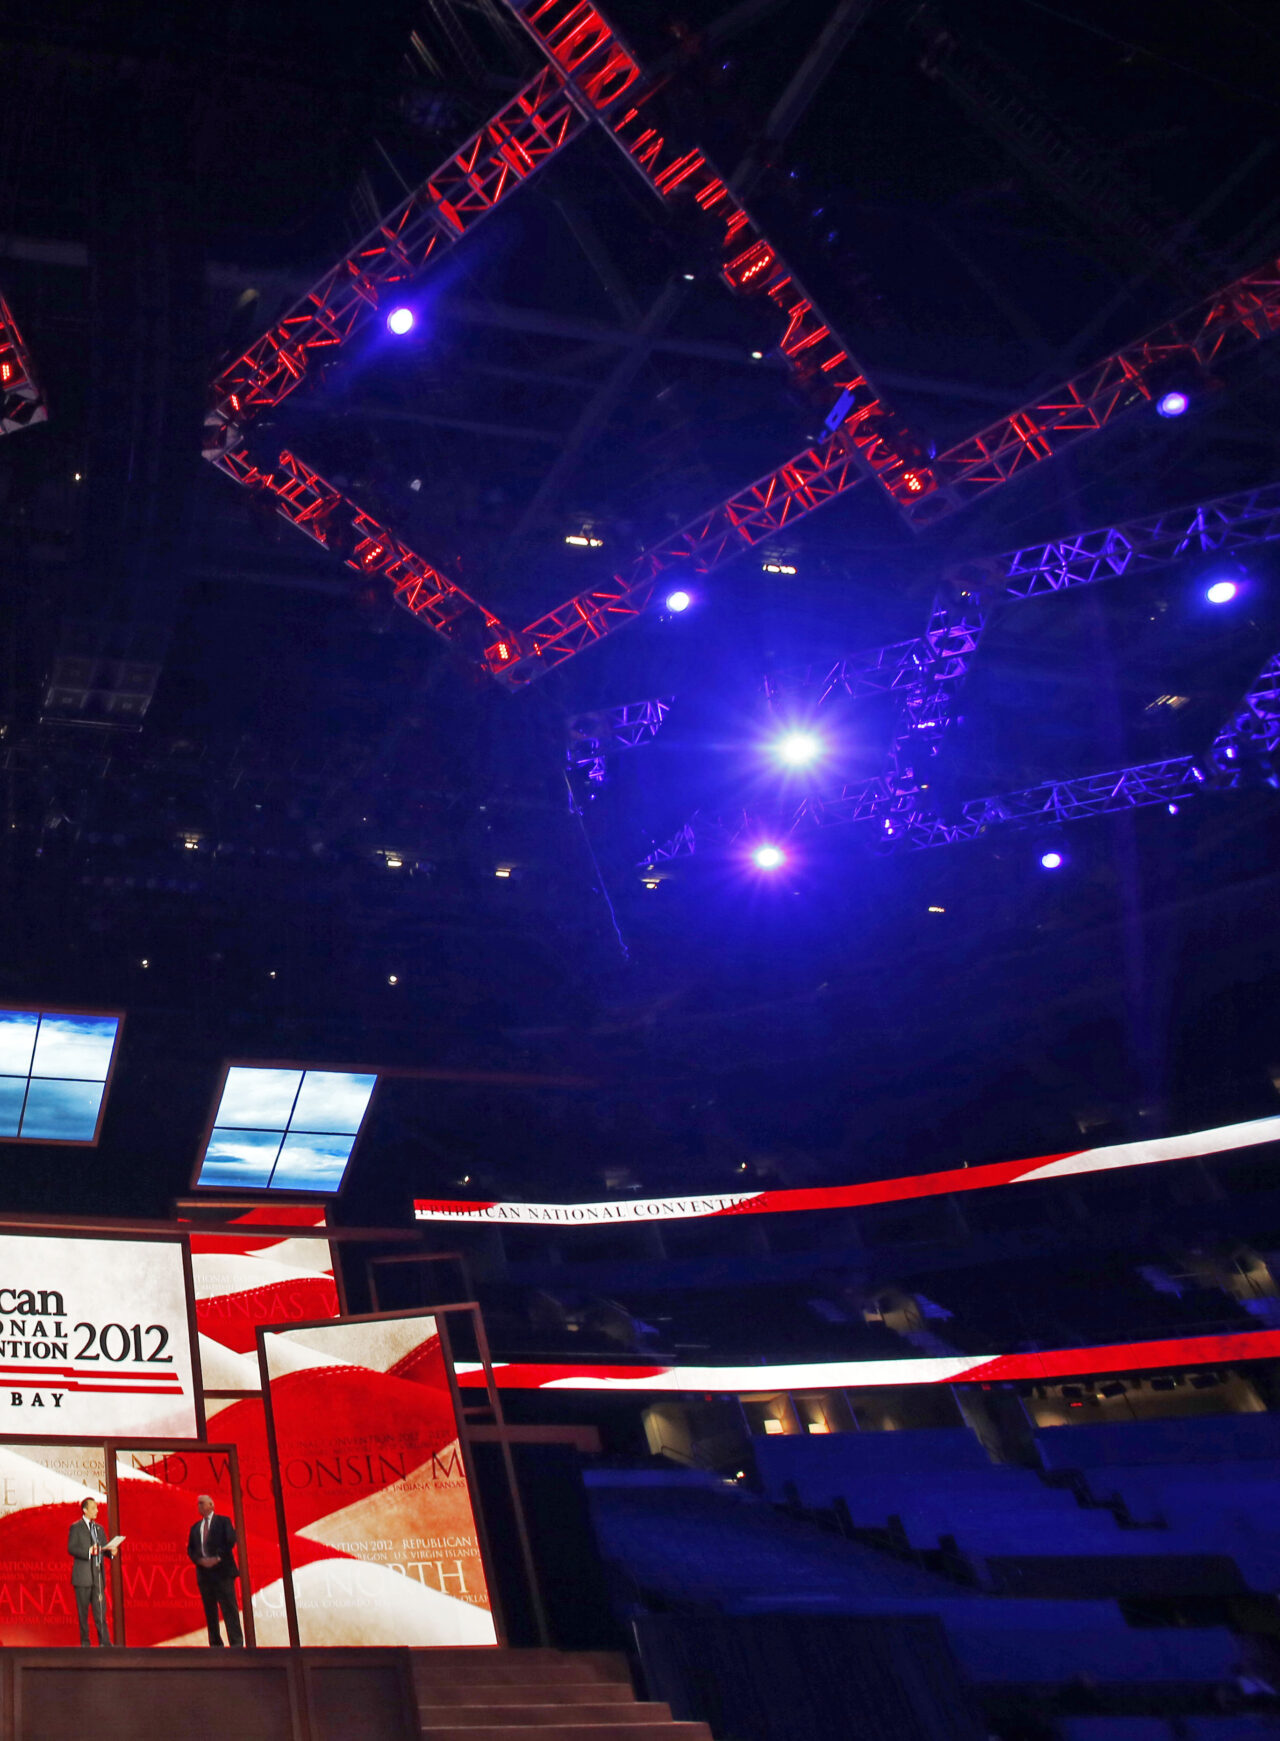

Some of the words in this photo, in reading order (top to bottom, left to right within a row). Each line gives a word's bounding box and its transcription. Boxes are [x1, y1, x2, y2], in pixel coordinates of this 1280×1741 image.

[528, 1205, 626, 1221] NATIONAL
[633, 1195, 769, 1217] CONVENTION
[73, 1321, 174, 1363] 2012
[11, 1391, 65, 1408] BAY
[285, 1452, 407, 1489] ONSIN
[431, 1449, 466, 1480] M
[393, 1482, 430, 1492] INDIANA
[371, 1540, 393, 1550] 2012
[402, 1535, 472, 1550] REPUBLICAN
[410, 1549, 443, 1559] VIRGIN
